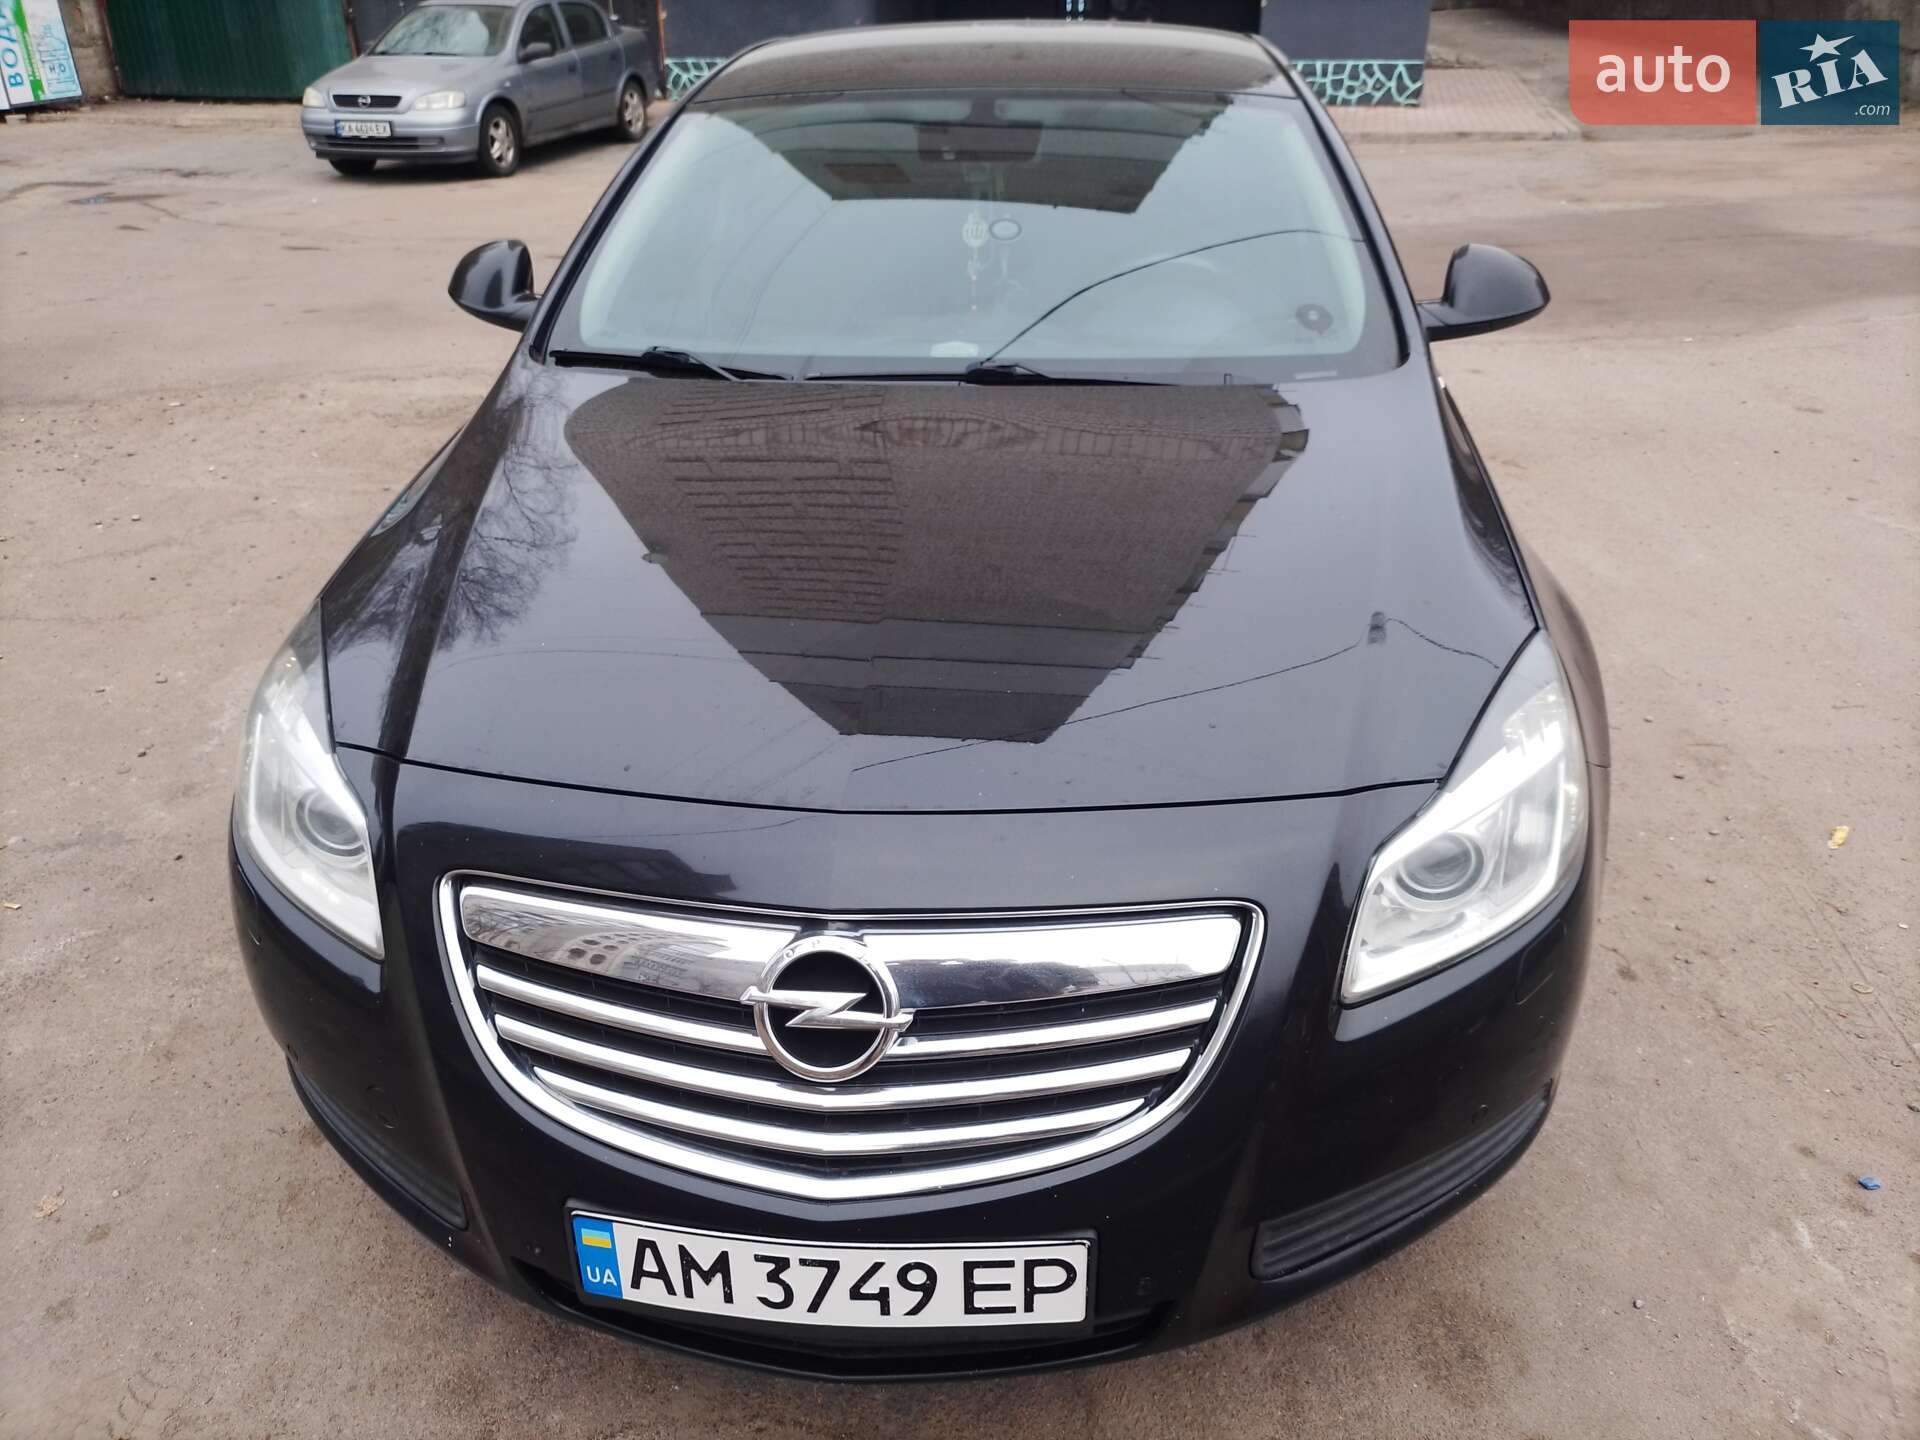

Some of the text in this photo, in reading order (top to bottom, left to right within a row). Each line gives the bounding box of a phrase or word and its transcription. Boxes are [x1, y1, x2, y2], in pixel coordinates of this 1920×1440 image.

[586, 1265, 618, 1287] UA
[630, 1238, 1077, 1317] AM 3749 EP
